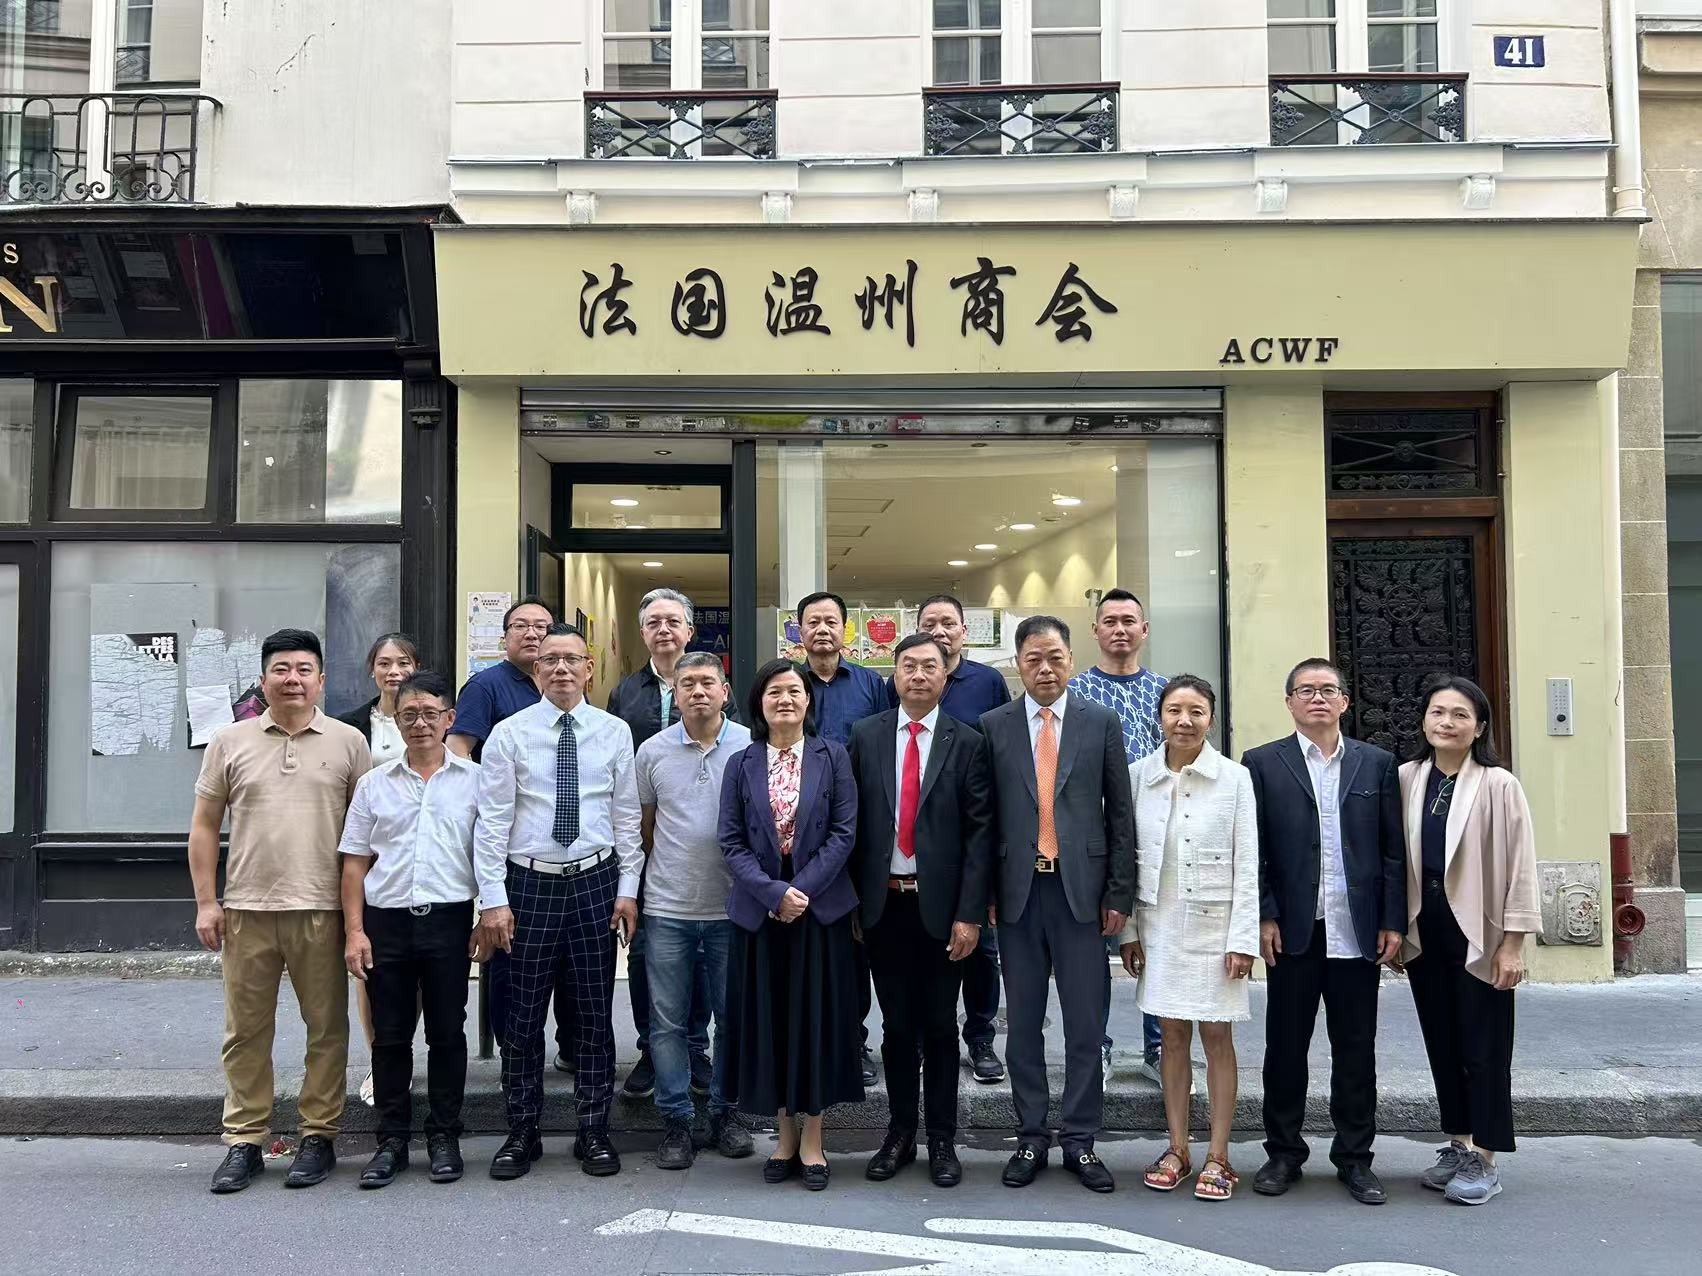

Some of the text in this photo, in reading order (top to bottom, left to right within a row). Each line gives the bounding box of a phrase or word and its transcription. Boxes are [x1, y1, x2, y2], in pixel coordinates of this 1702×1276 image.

[1504, 38, 1535, 65] 41
[3, 243, 19, 264] S
[579, 256, 1118, 348] 法国温州商会
[1219, 337, 1339, 365] ACWF
[152, 636, 174, 646] DES
